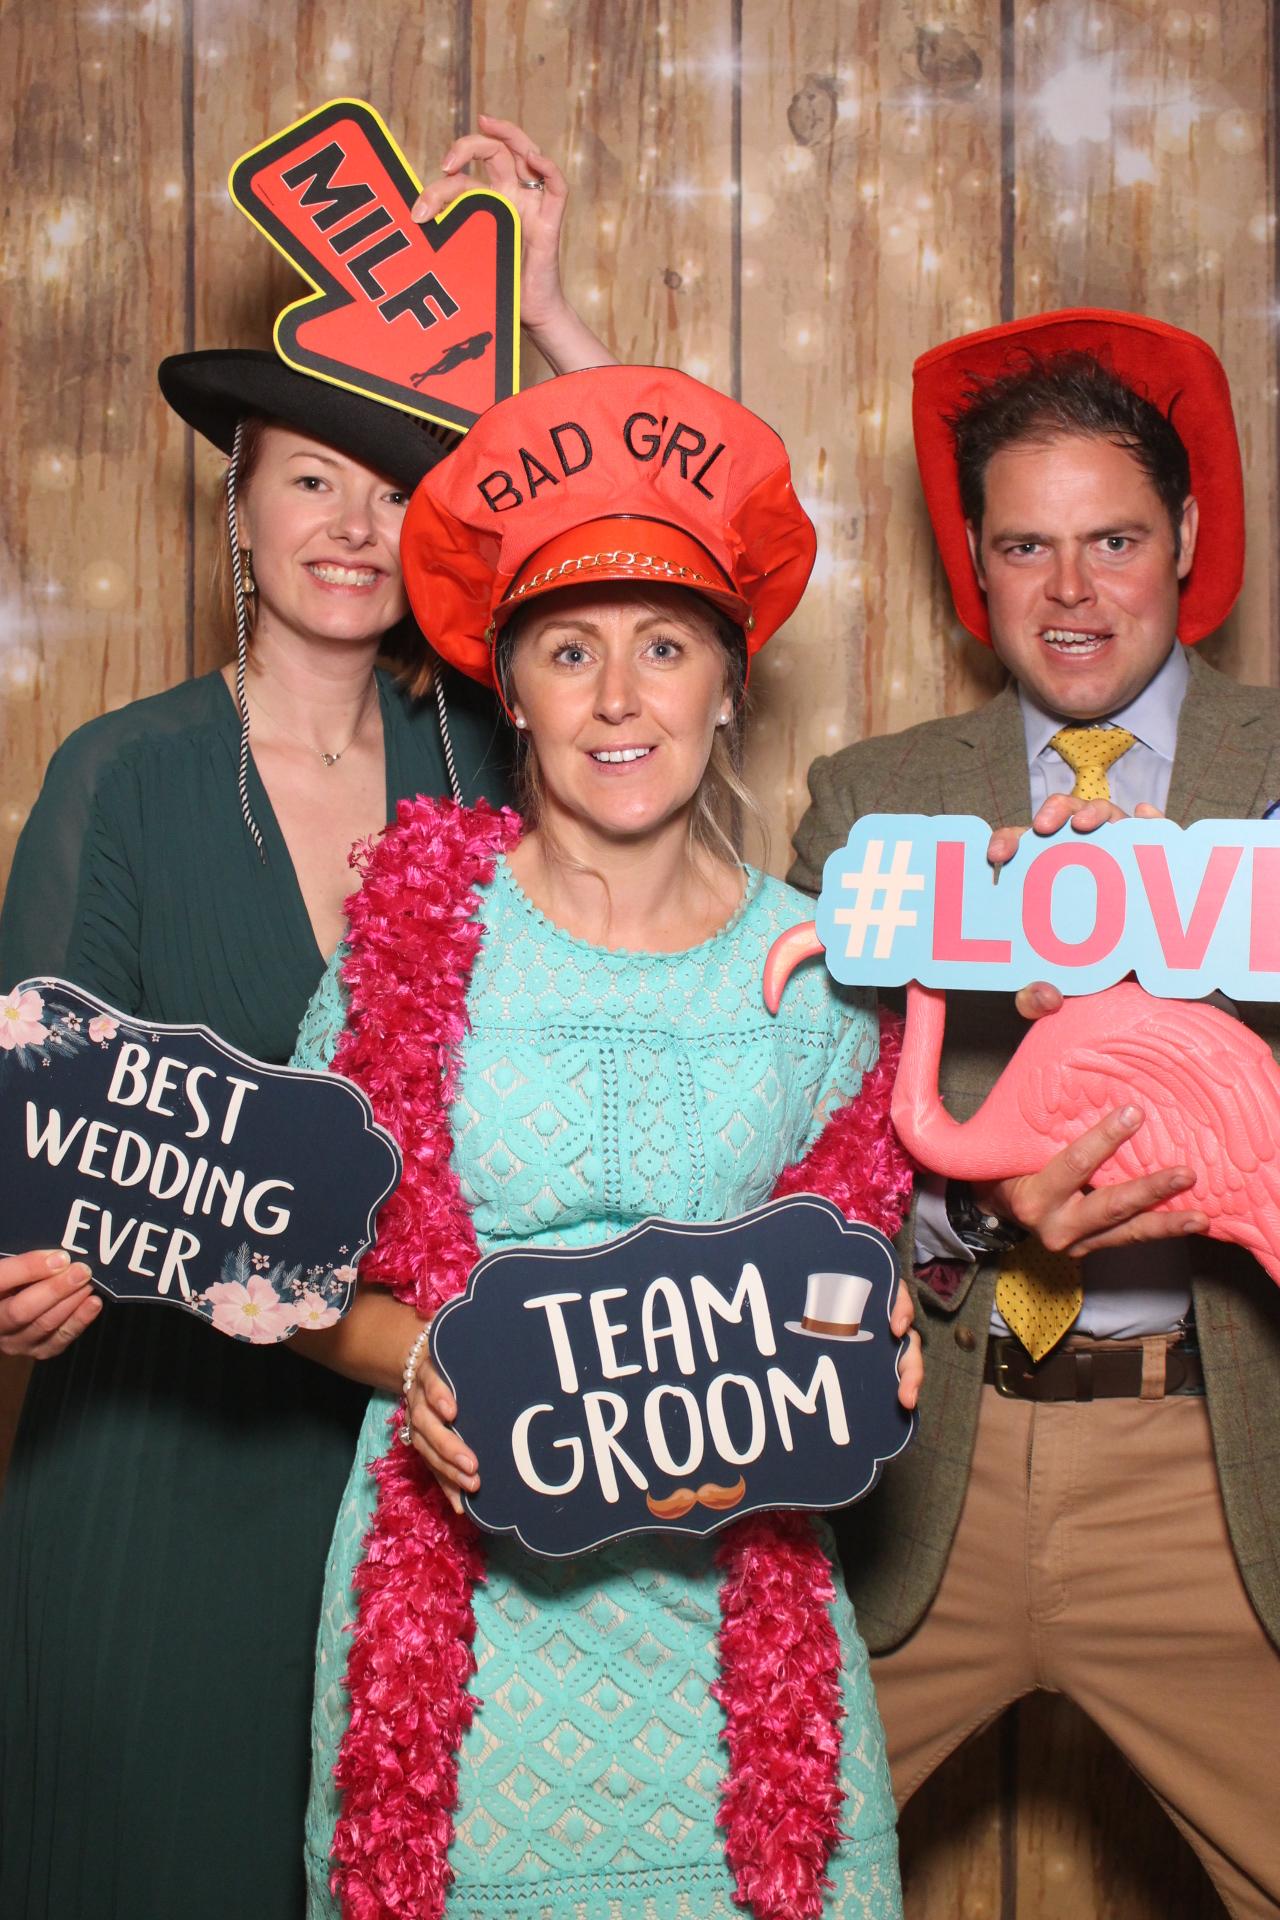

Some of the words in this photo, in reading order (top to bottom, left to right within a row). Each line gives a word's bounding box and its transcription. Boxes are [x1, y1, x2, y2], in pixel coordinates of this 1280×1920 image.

[280, 141, 460, 330] MILF
[477, 421, 593, 513] BAD
[107, 1043, 259, 1145] BEST
[26, 1101, 295, 1235] WEDDING
[61, 1199, 201, 1297] EVER
[523, 1262, 777, 1394] TEAM
[511, 1355, 850, 1503] GROOM
